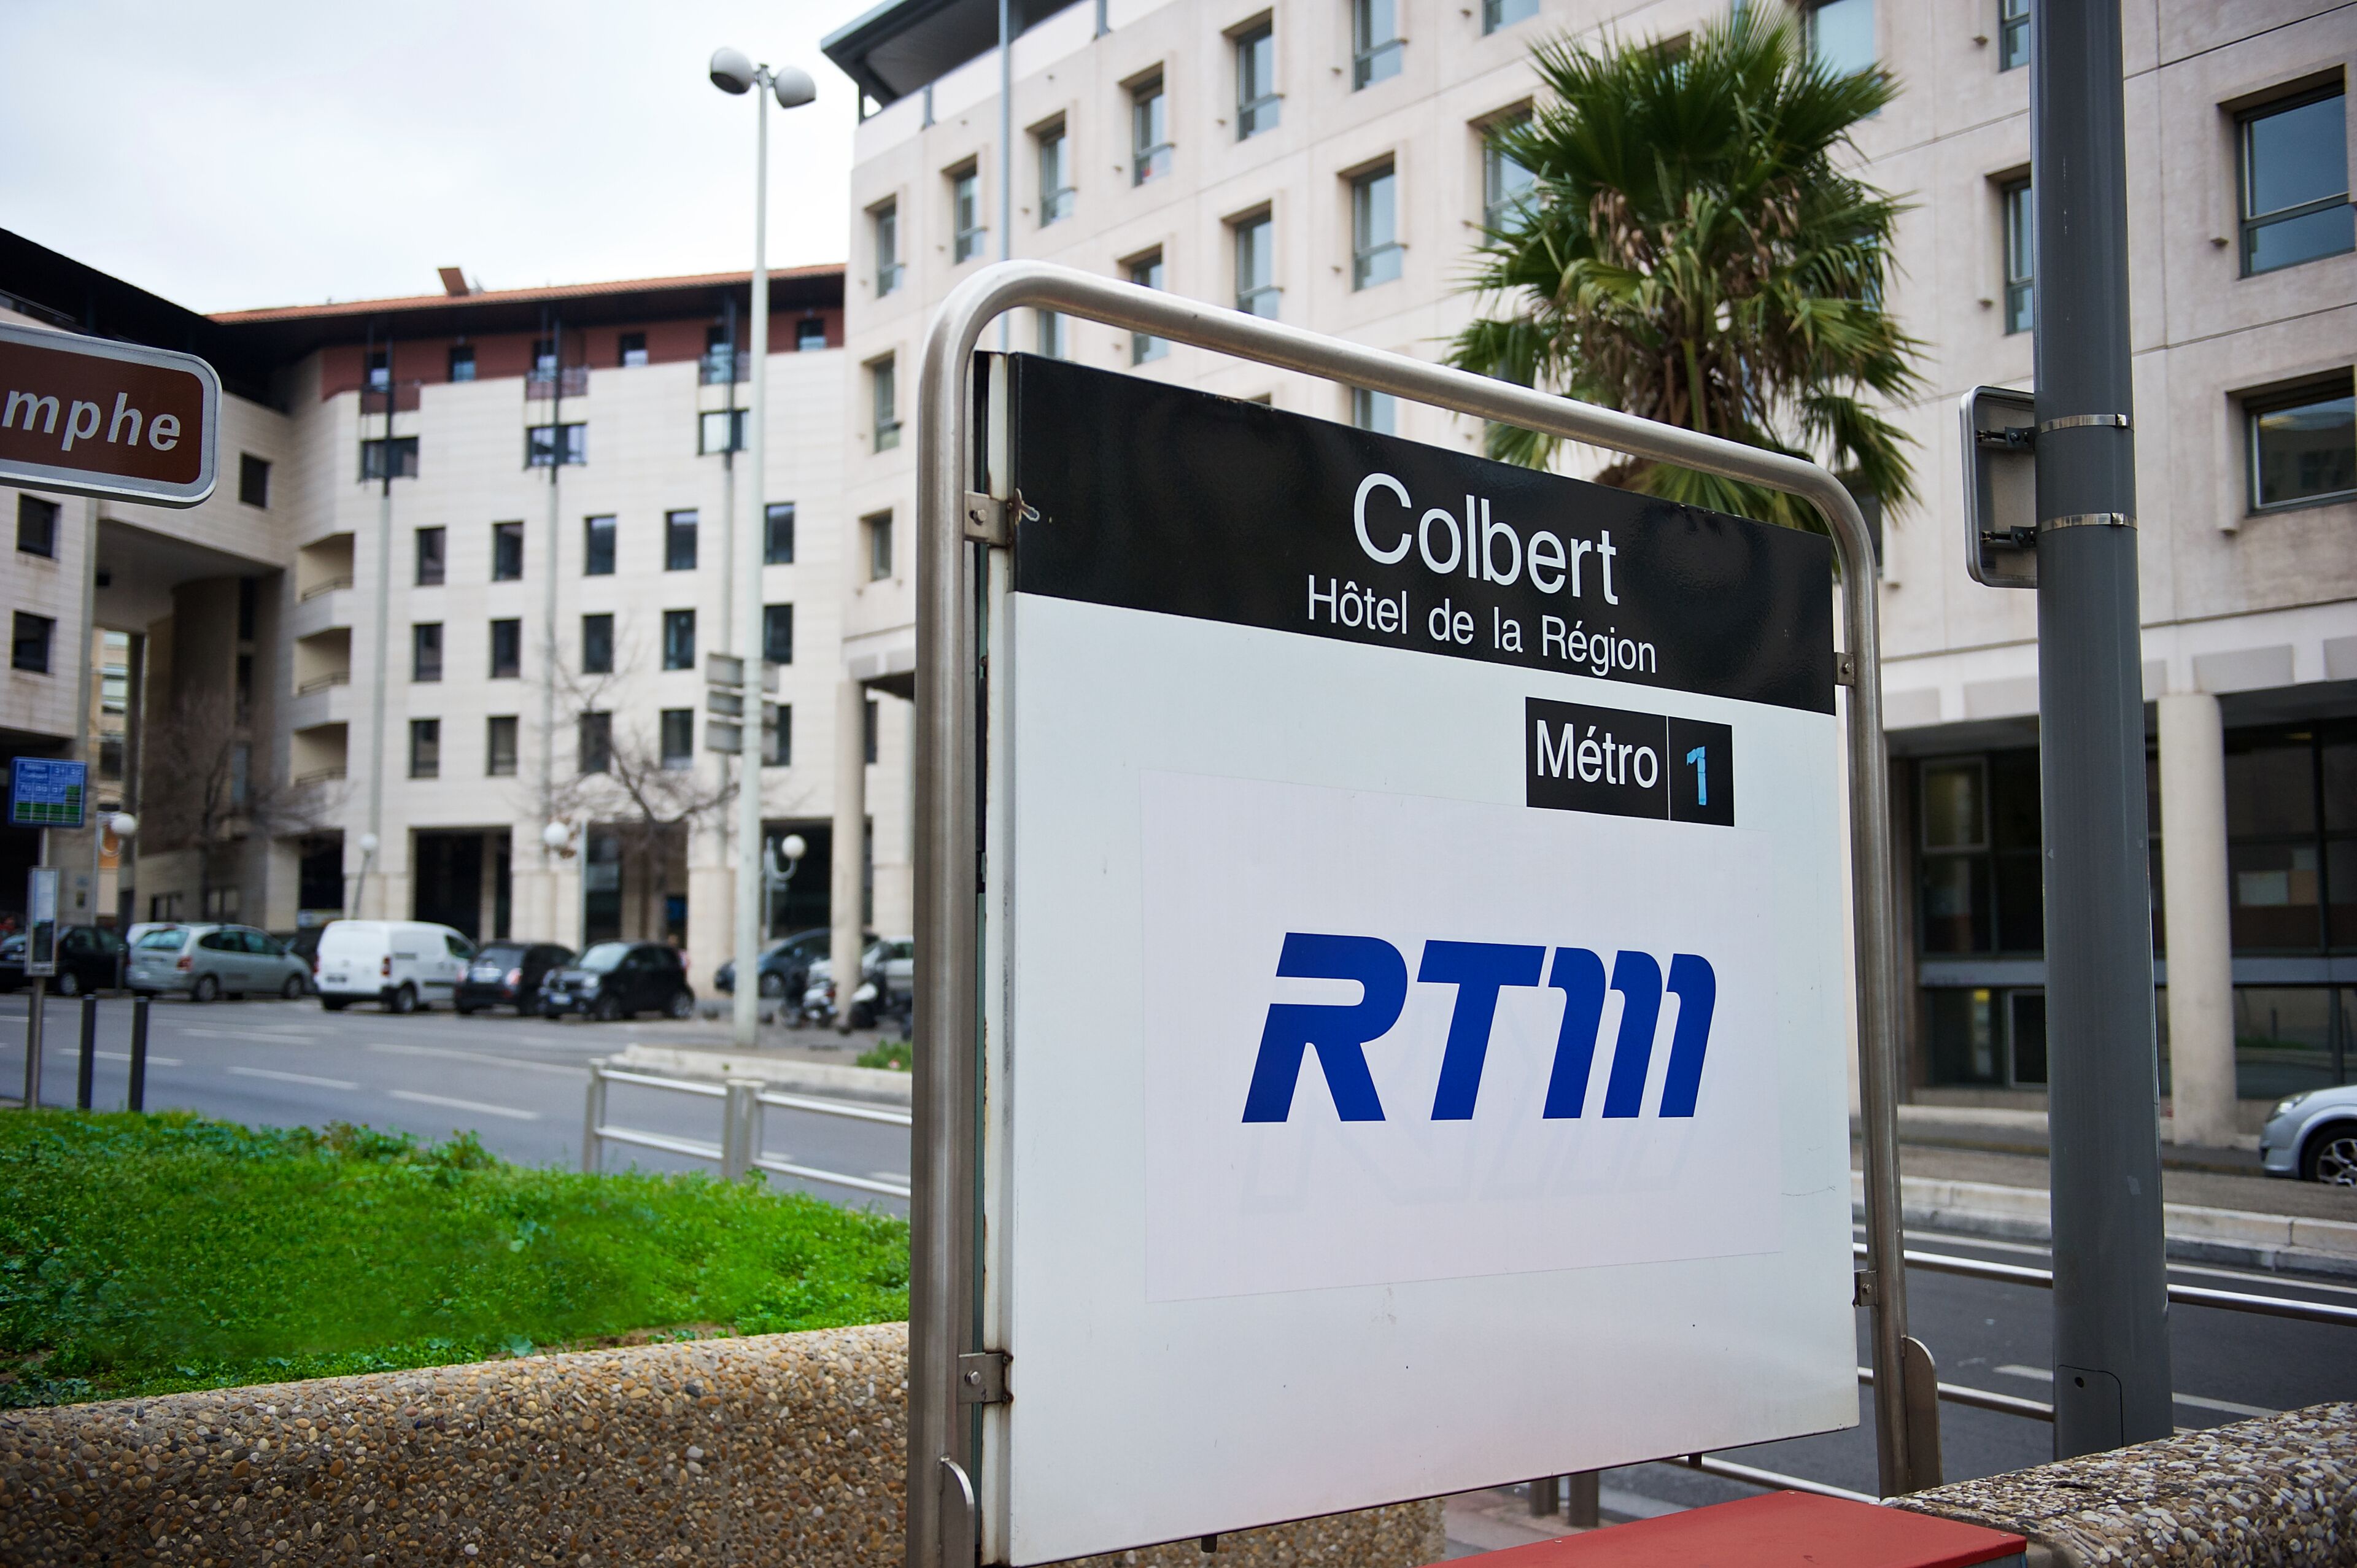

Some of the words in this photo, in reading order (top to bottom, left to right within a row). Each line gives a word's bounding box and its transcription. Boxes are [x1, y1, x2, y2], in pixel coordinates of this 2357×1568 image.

[2, 390, 180, 451] mphe
[1354, 473, 1619, 605] Colbert
[1309, 574, 1407, 635] Hôtel
[1428, 598, 1474, 644] de
[1494, 606, 1523, 653] la
[1542, 614, 1656, 676] Région
[1537, 719, 1658, 788] Métro
[1686, 745, 1708, 806] 1
[1242, 932, 1716, 1122] RTM
